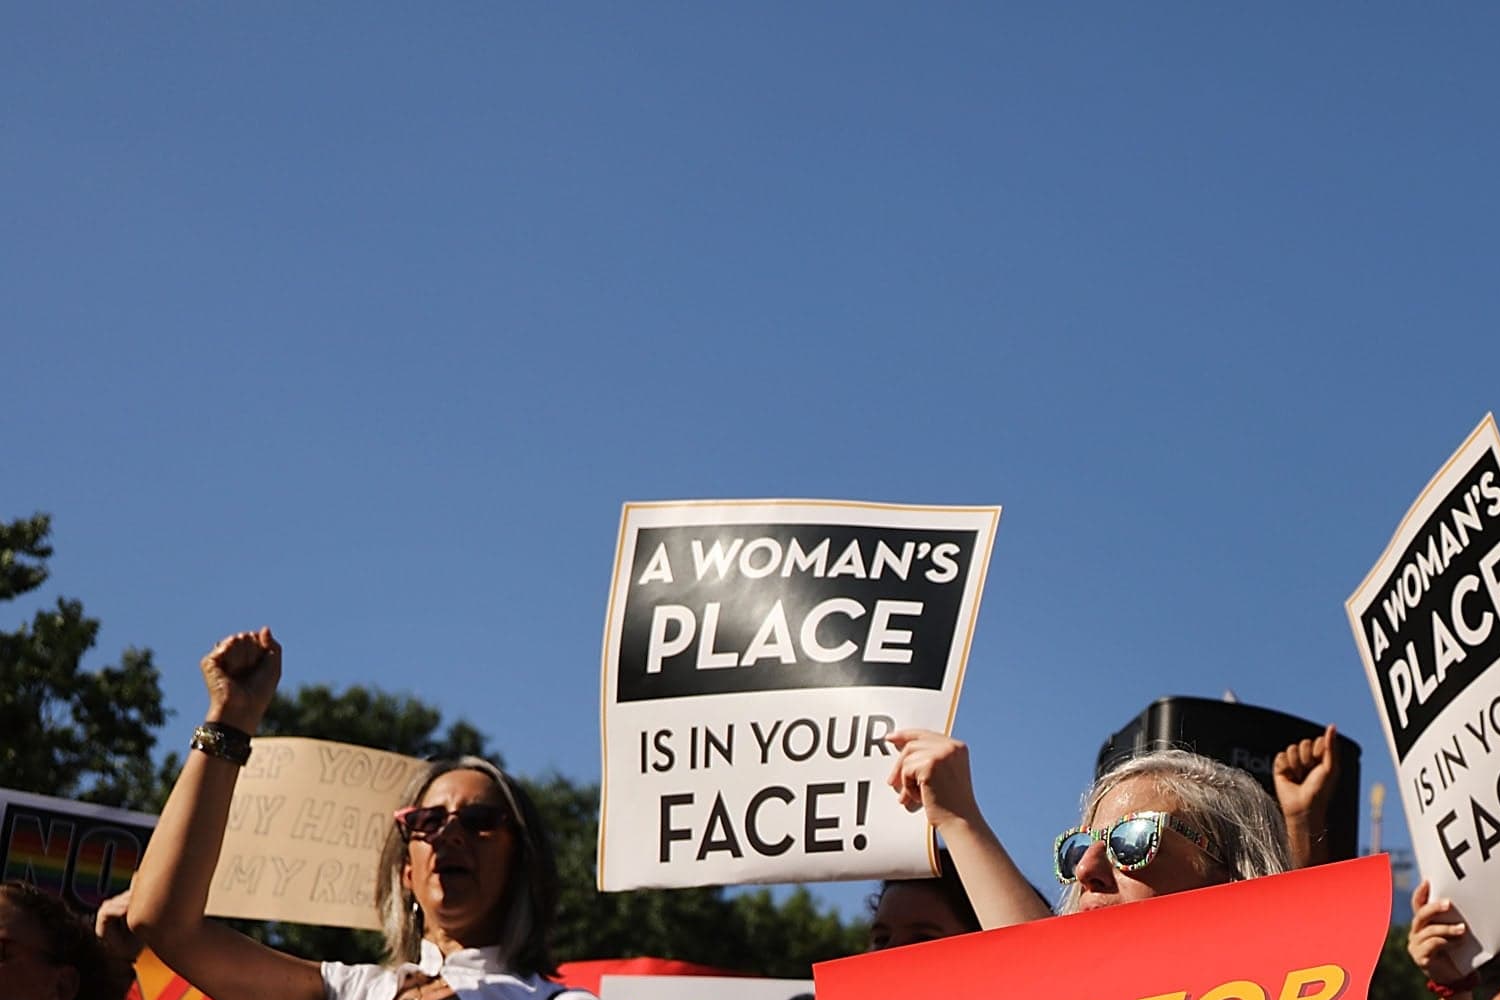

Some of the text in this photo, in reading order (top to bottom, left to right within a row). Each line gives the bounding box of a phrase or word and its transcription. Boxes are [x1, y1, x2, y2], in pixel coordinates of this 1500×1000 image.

[639, 536, 960, 585] A WOMAN'S
[646, 598, 924, 674] PLACE
[1372, 617, 1390, 662] A
[640, 714, 896, 774] IS IN YOUR
[1414, 767, 1435, 815] IS
[1434, 735, 1469, 790] IN
[659, 780, 871, 863] FACE!
